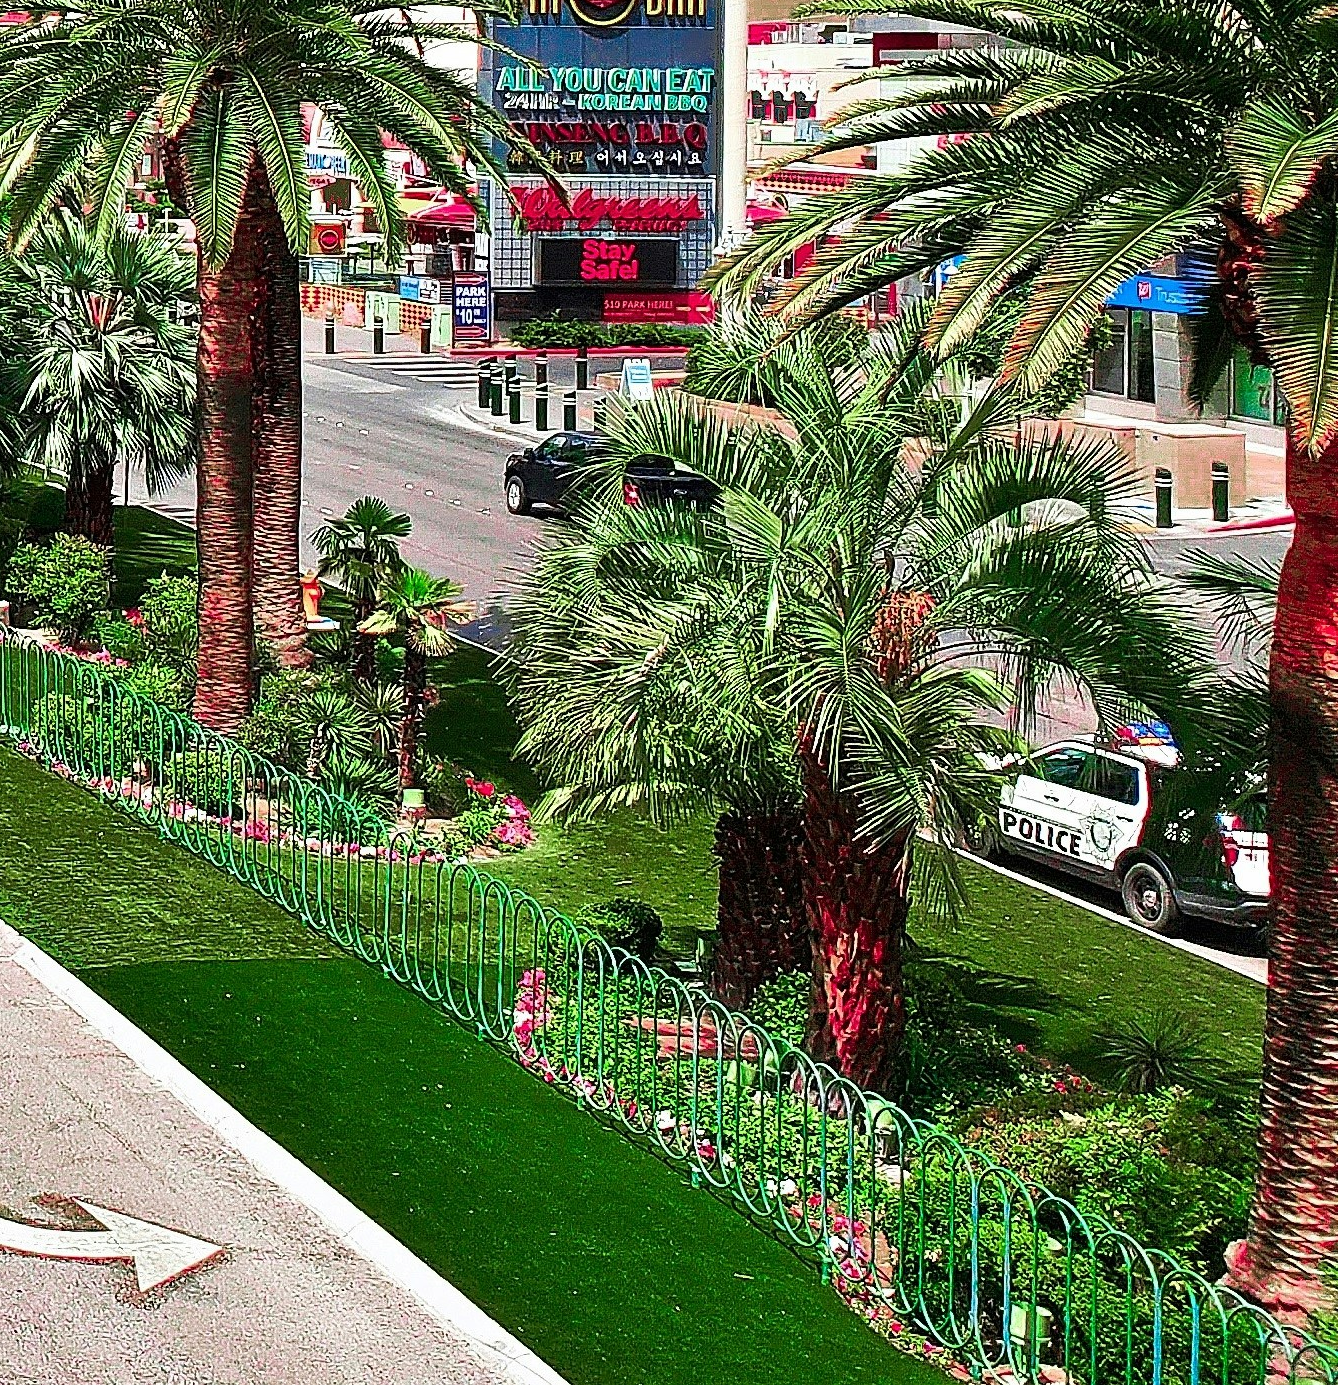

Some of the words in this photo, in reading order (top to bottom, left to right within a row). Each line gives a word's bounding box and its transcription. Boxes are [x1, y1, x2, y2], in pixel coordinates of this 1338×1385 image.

[496, 66, 545, 92] ALL
[550, 67, 602, 92] YOU
[607, 67, 661, 93] CAN
[665, 68, 714, 93] EAT
[578, 93, 661, 111] KOREAN
[664, 94, 708, 112] BBQ
[582, 239, 636, 261] Stay
[580, 260, 639, 281] Safe!
[455, 286, 487, 296] PARK
[455, 297, 487, 306] HERE
[603, 300, 621, 309] $10
[622, 300, 646, 309] PARK
[1003, 811, 1082, 856] POLICE
